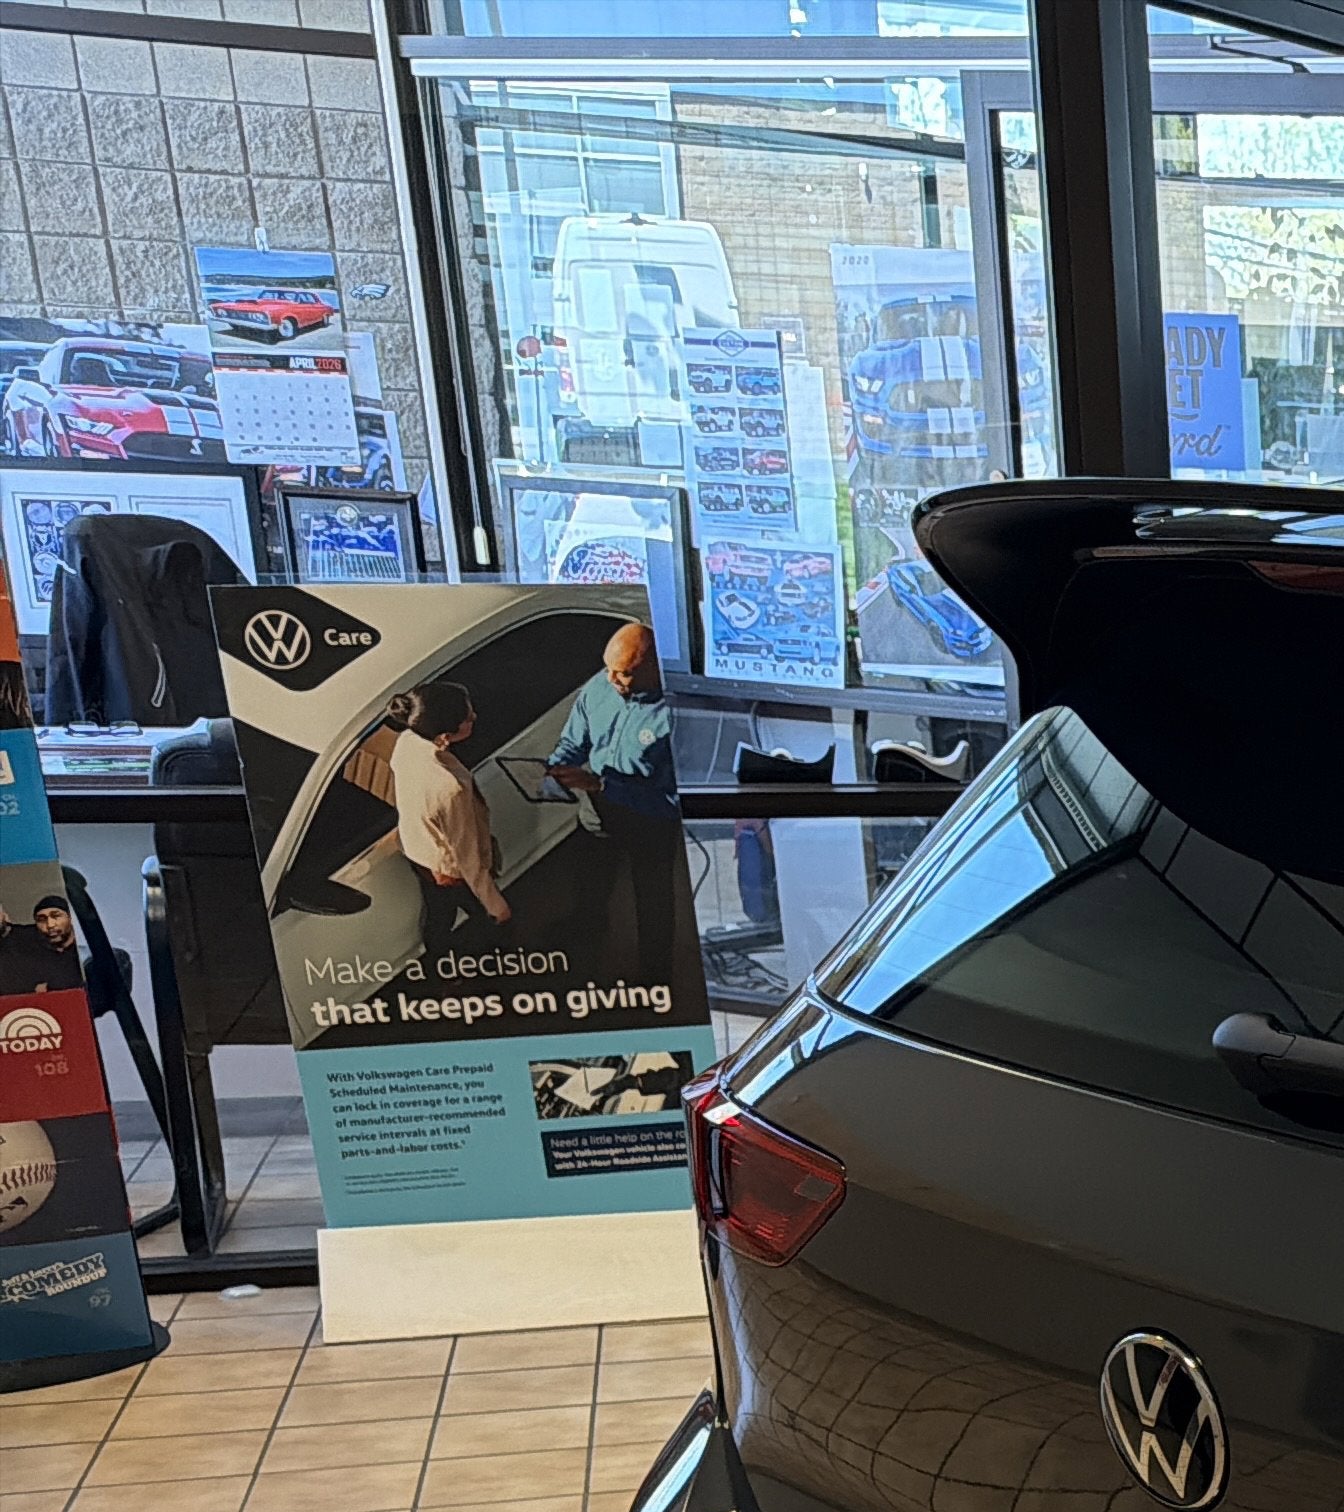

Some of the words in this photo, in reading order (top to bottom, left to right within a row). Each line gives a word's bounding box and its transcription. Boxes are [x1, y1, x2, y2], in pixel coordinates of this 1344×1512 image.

[290, 357, 316, 369] APRIL
[316, 359, 342, 370] 2026
[323, 628, 373, 646] Care
[715, 659, 834, 679] MUSTANG
[304, 954, 394, 986] Make
[405, 956, 427, 981] a
[437, 947, 569, 980] decision
[310, 994, 391, 1027] that
[399, 993, 504, 1025] keeps
[512, 991, 558, 1015] on
[566, 979, 673, 1018] giving
[0, 1036, 63, 1054] TODAY
[34, 1060, 70, 1077] 108
[327, 1072, 355, 1083] With
[357, 1069, 424, 1082] Volkswagen
[425, 1067, 450, 1077] Care
[452, 1063, 494, 1076] Prepaid
[329, 1086, 387, 1098] Scheduled
[389, 1081, 463, 1093] Maintenance,
[464, 1081, 485, 1091] you
[333, 1105, 352, 1113] can
[354, 1100, 378, 1111] lock
[380, 1099, 391, 1109] in
[393, 1097, 443, 1110] coverage
[444, 1096, 461, 1105] for
[462, 1096, 470, 1104] a
[471, 1094, 503, 1104] range
[335, 1118, 347, 1128] of
[350, 1107, 506, 1126] manufacturer-recommended
[338, 1133, 377, 1143] service
[379, 1127, 428, 1140] intervals
[430, 1127, 441, 1136] at
[443, 1124, 471, 1136] fixed
[550, 1138, 579, 1149] Need
[581, 1138, 589, 1146] a
[590, 1135, 613, 1145] little
[615, 1134, 638, 1144] help
[640, 1133, 655, 1141] on
[656, 1131, 673, 1140] the
[341, 1142, 429, 1160] parts-and-labor
[574, 1148, 625, 1158] Volkswagen
[6, 1253, 104, 1297] COMEDY
[89, 1295, 112, 1308] 97
